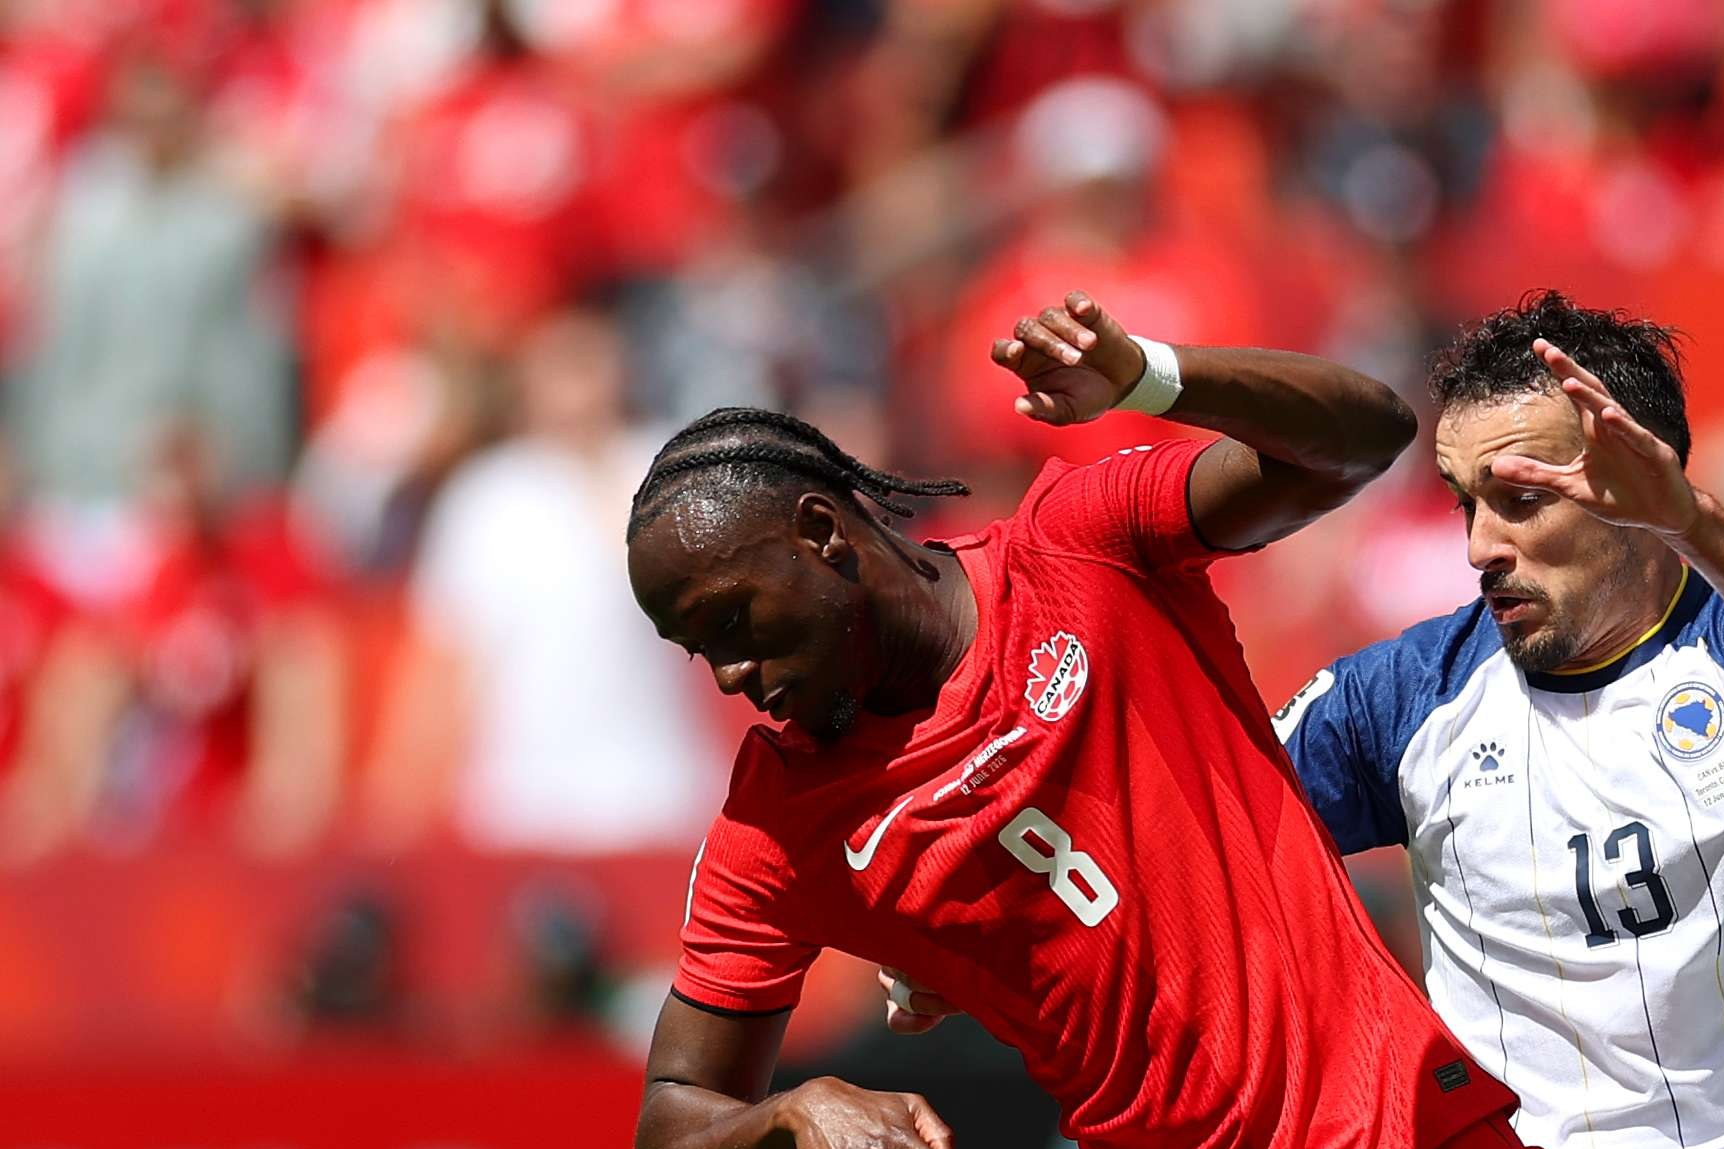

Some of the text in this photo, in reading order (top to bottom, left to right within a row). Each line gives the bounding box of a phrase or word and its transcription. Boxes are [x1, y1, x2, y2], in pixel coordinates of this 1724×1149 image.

[1037, 641, 1079, 715] CANADA
[1464, 773, 1515, 789] KELME
[999, 807, 1120, 927] 8
[1567, 820, 1679, 949] 13
